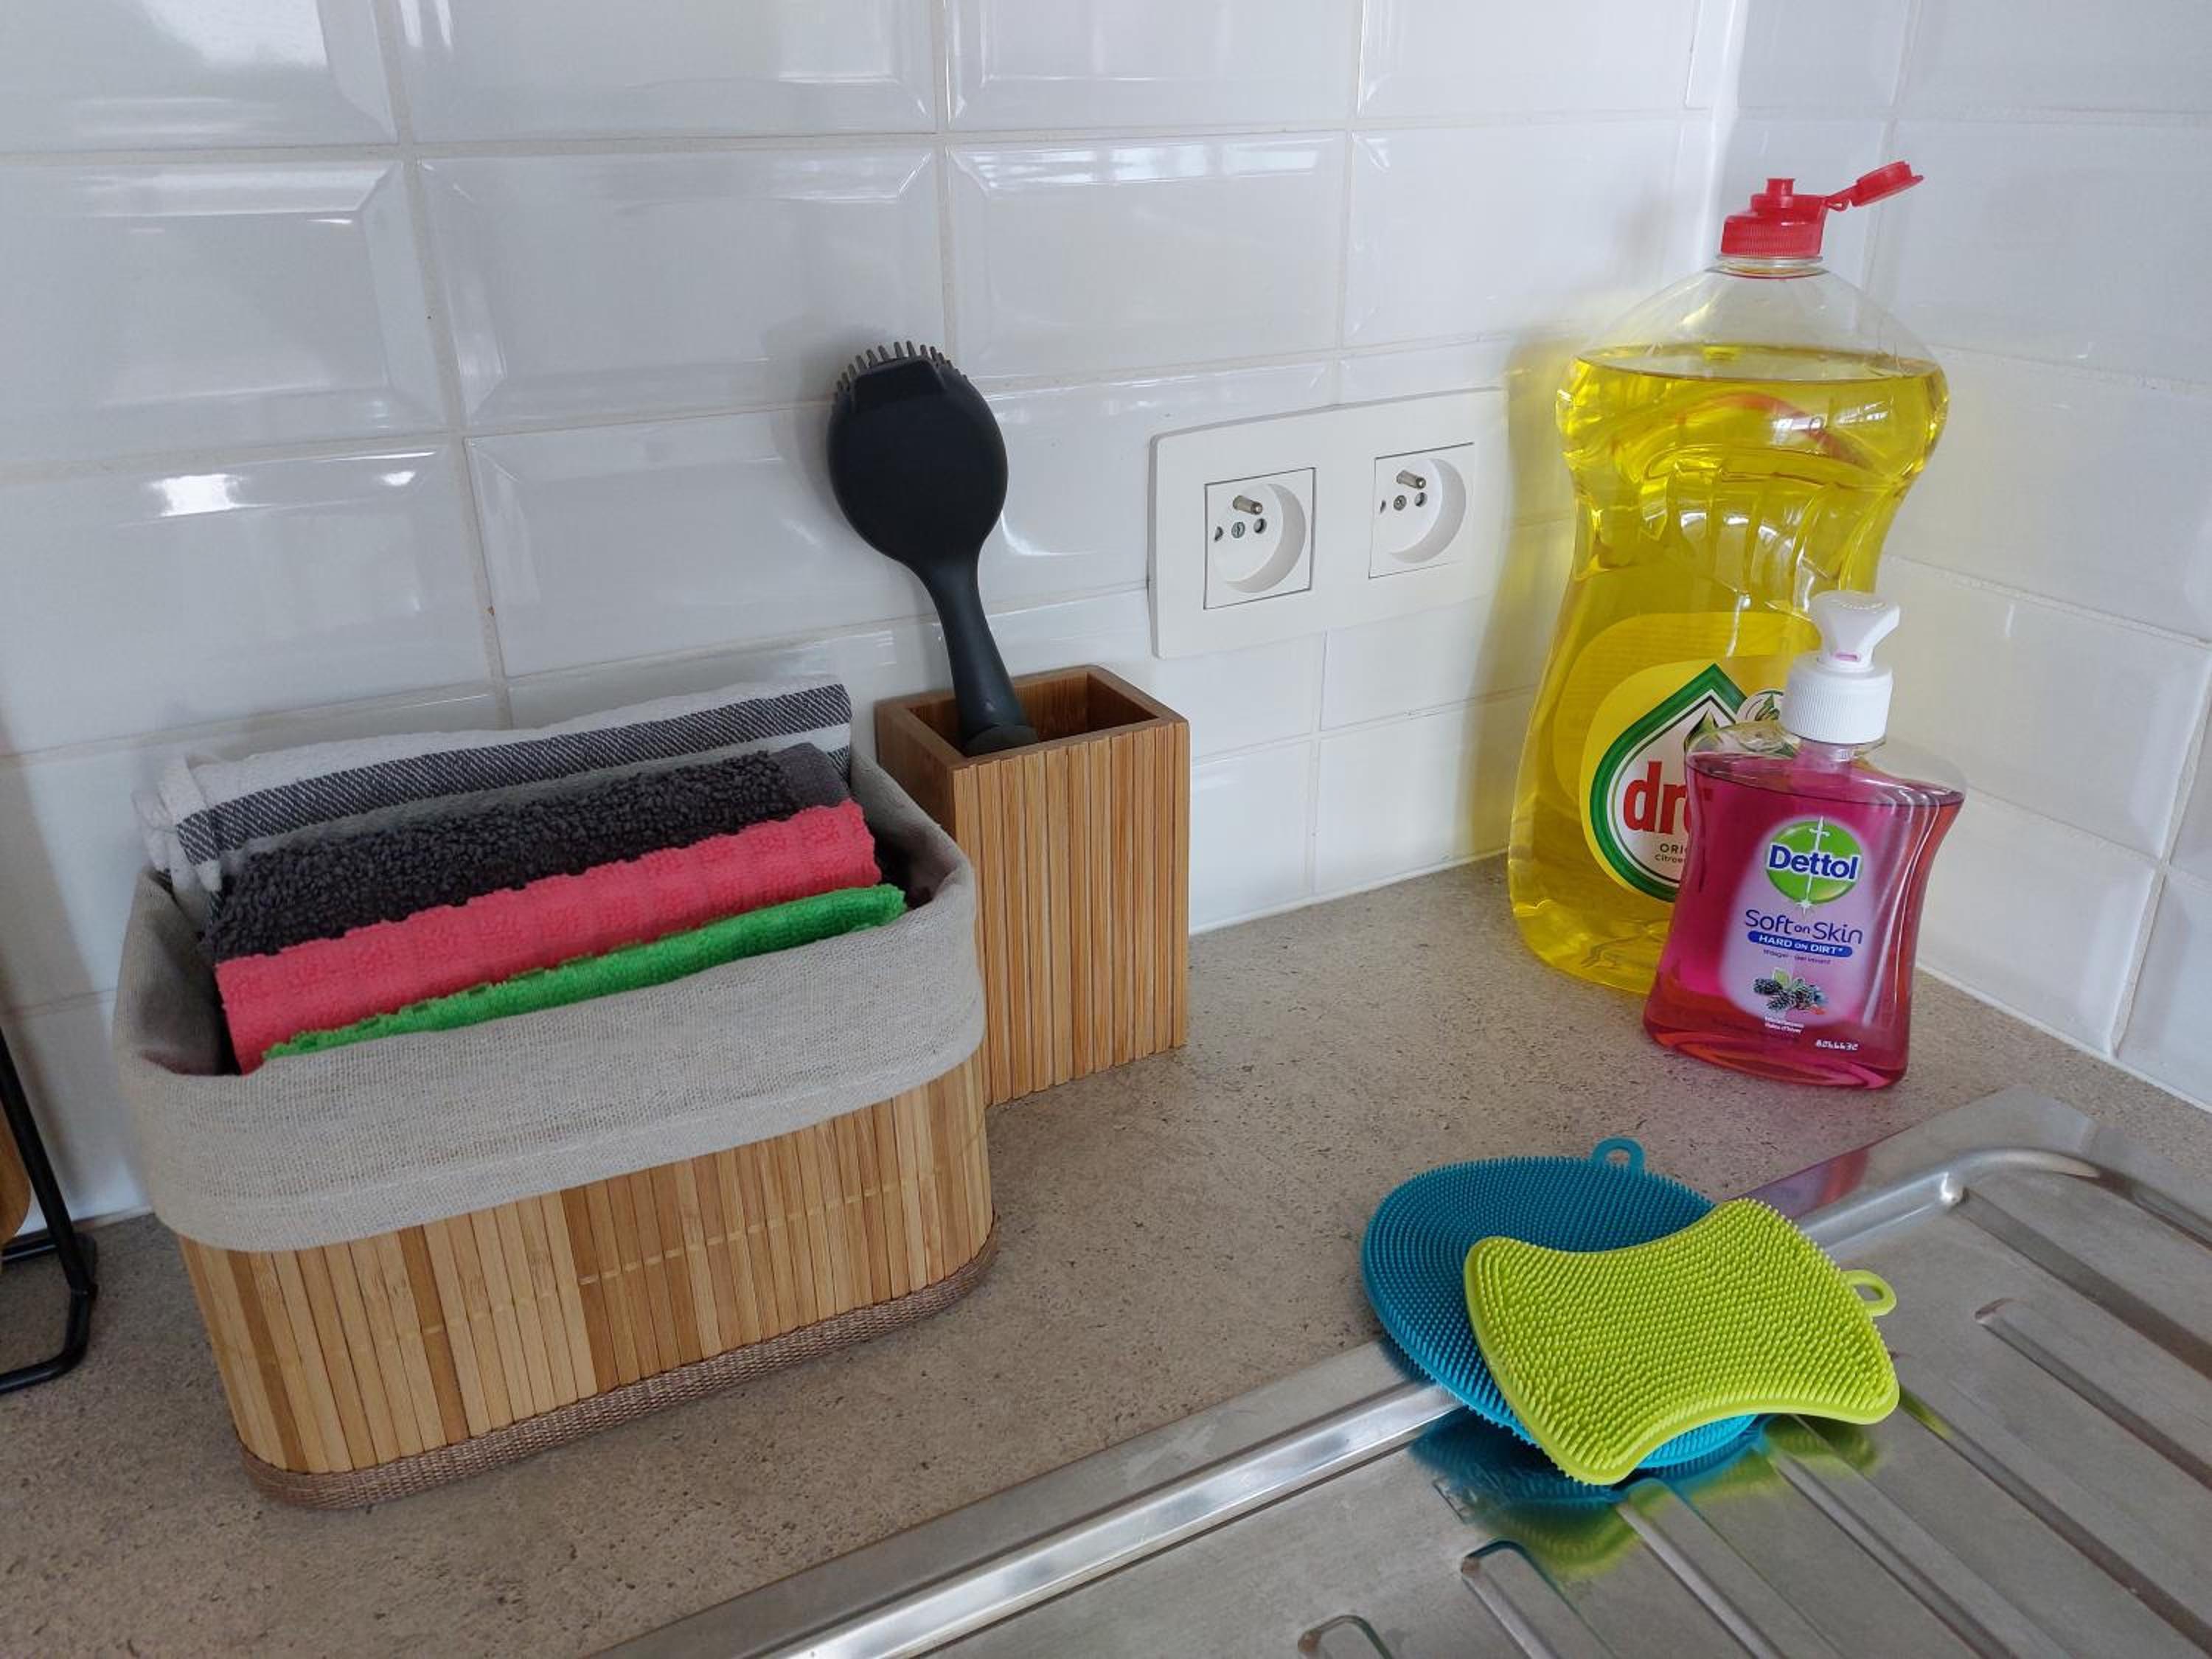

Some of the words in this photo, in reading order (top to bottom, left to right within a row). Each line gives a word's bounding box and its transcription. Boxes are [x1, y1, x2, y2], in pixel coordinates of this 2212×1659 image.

[1660, 844, 1687, 854] ORI
[1769, 845, 1858, 880] Dettol
[1745, 909, 1793, 934] Soft
[1795, 925, 1810, 934] on
[1812, 922, 1863, 944] Skin
[1759, 934, 1792, 947] HARD
